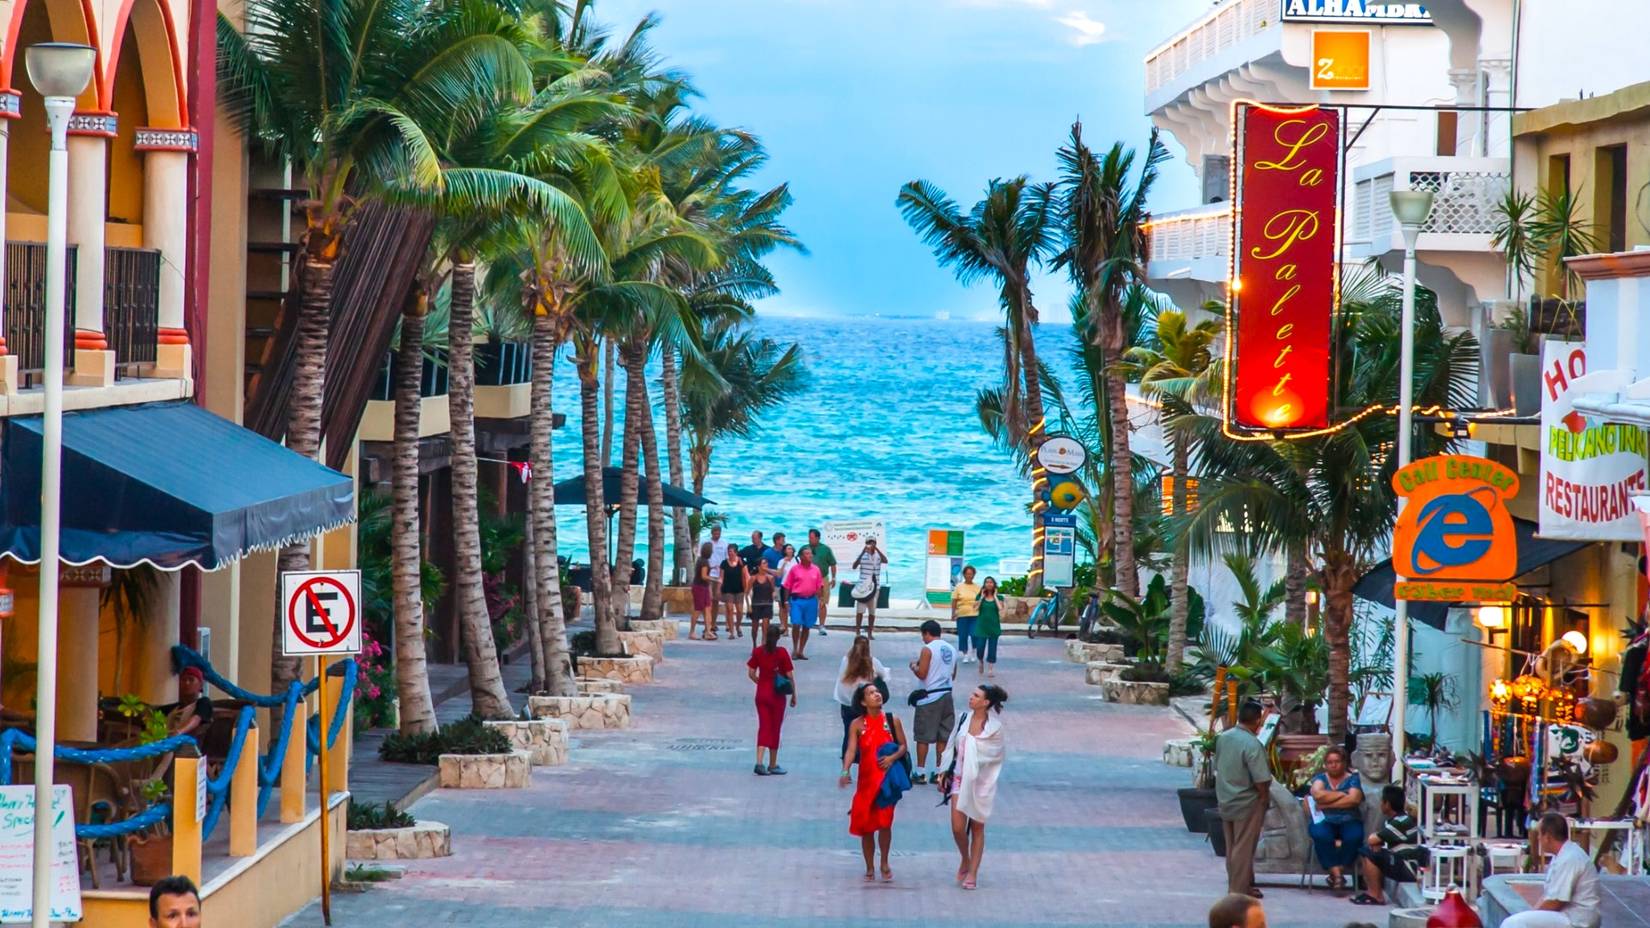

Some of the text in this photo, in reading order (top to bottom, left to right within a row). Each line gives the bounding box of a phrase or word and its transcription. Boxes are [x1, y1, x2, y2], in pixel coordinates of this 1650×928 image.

[1250, 119, 1328, 416] La Palette
[1399, 458, 1515, 491] Call Center
[306, 592, 339, 633] E
